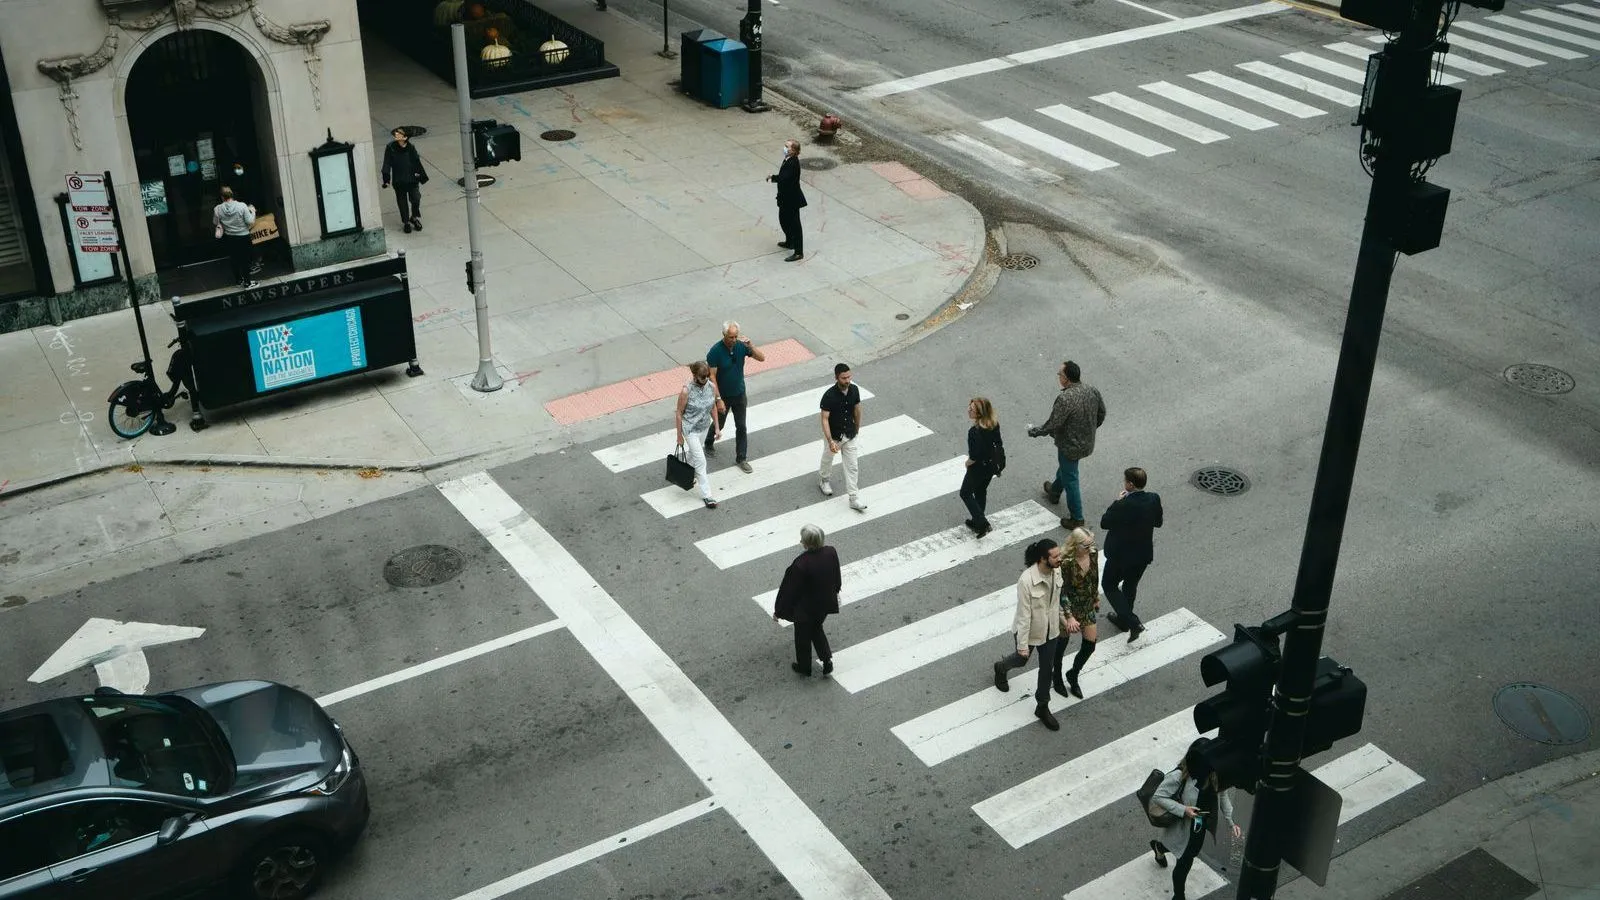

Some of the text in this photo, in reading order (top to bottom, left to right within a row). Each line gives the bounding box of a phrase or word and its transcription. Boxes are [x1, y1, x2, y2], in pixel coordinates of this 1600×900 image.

[222, 271, 355, 309] NEWSPAPERS
[258, 326, 285, 345] VAX
[263, 351, 313, 376] NATION
